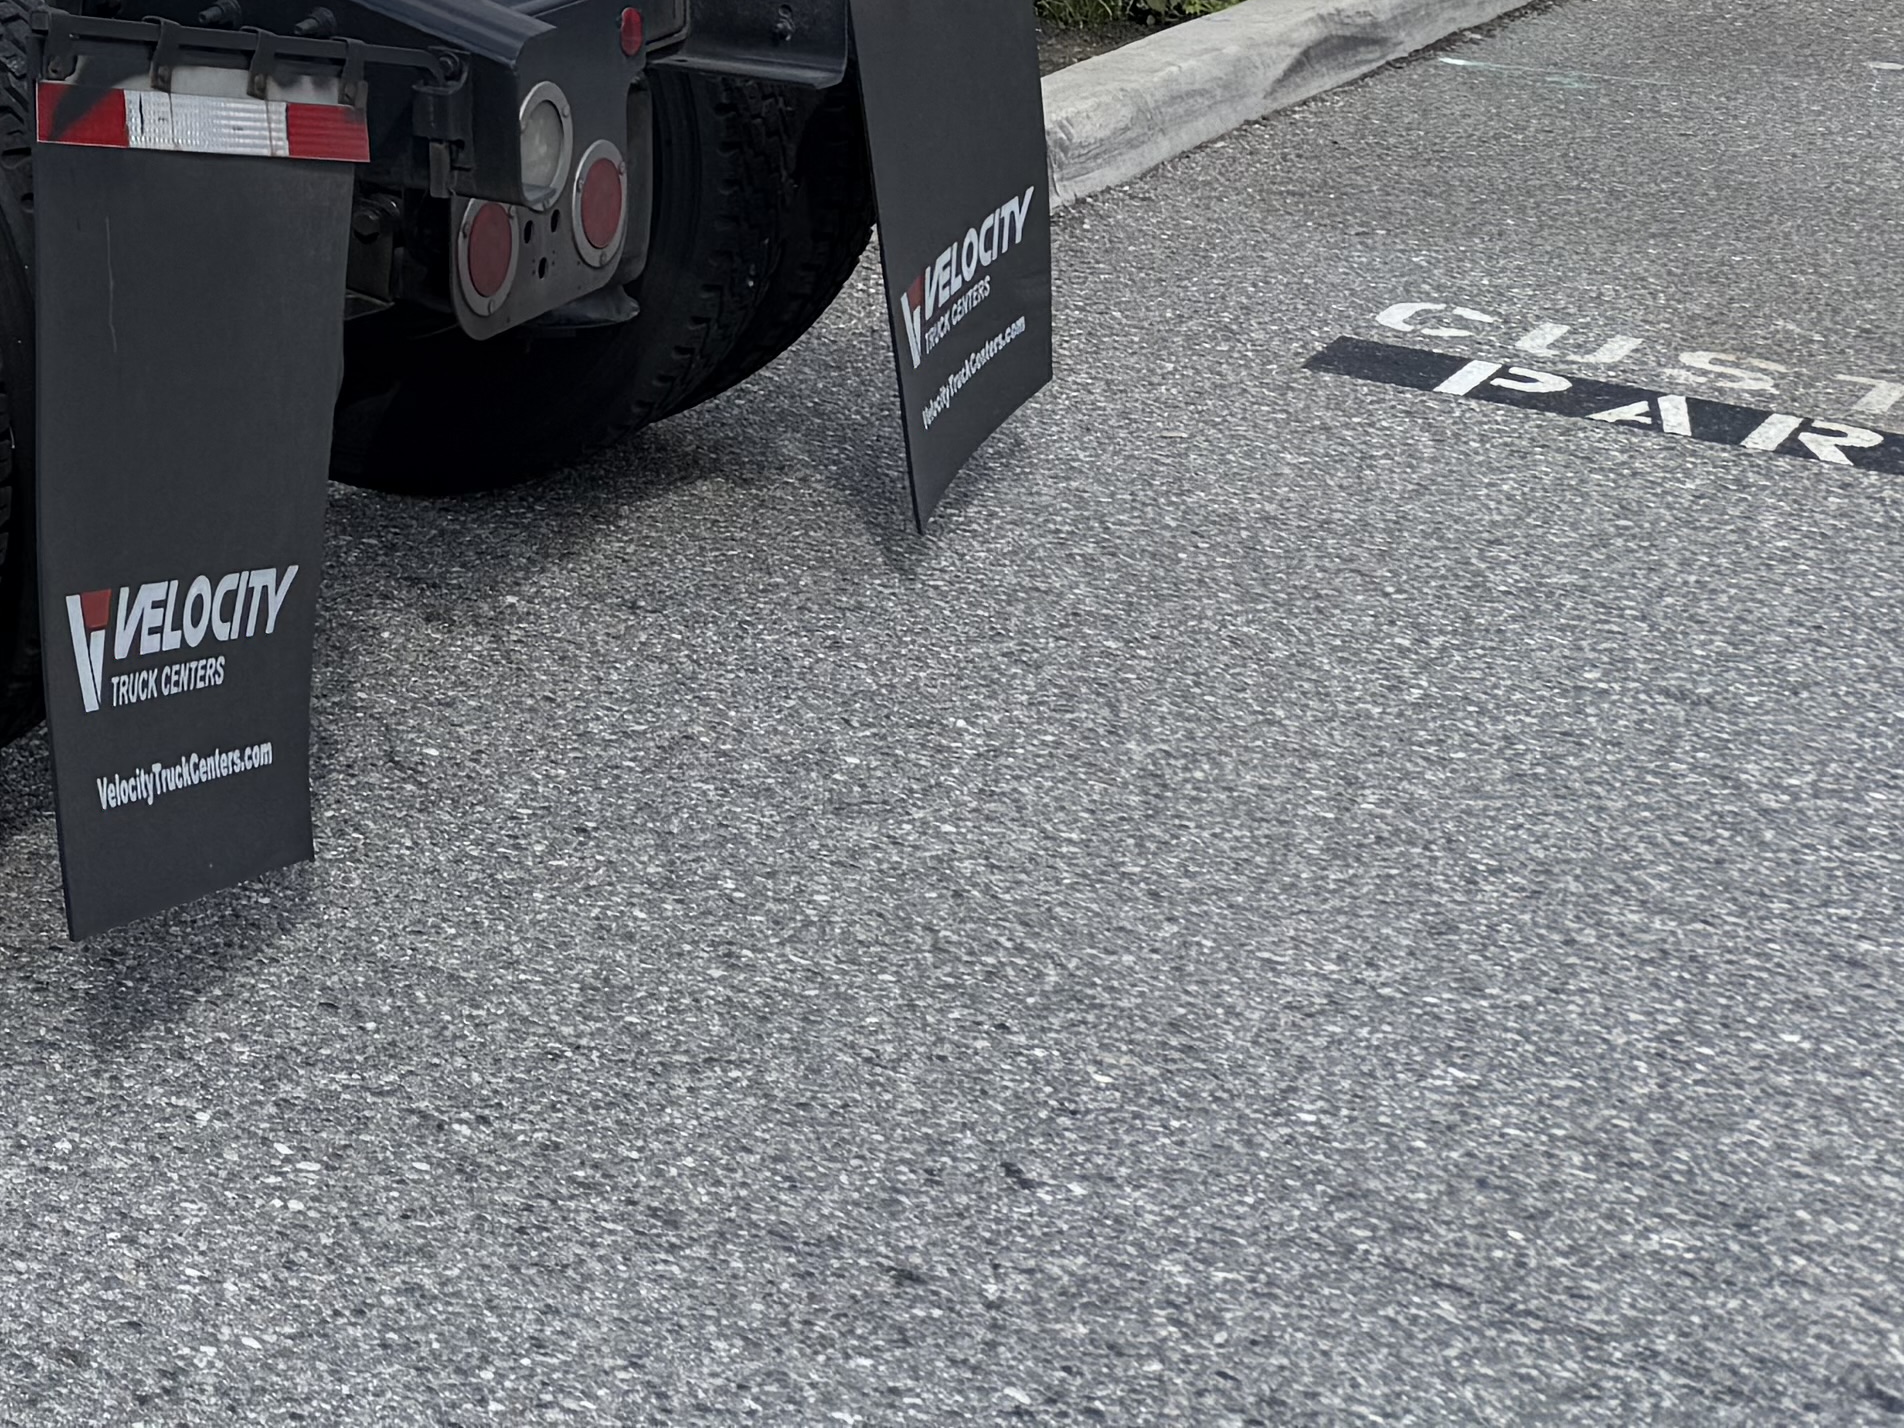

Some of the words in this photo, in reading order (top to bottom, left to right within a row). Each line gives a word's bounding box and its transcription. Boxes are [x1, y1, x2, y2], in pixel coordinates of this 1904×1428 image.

[923, 184, 1035, 322] VELOCITY
[924, 308, 952, 355] TRUCK
[951, 273, 992, 327] CENTERS
[921, 315, 1027, 431] VelocityTruckCenters.com
[1430, 359, 1885, 466] PAR
[113, 564, 300, 660] VELOCITY
[110, 667, 158, 708] TRUCK
[161, 655, 226, 697] CENTERS
[96, 741, 274, 811] VelocityTruckCenters.com
